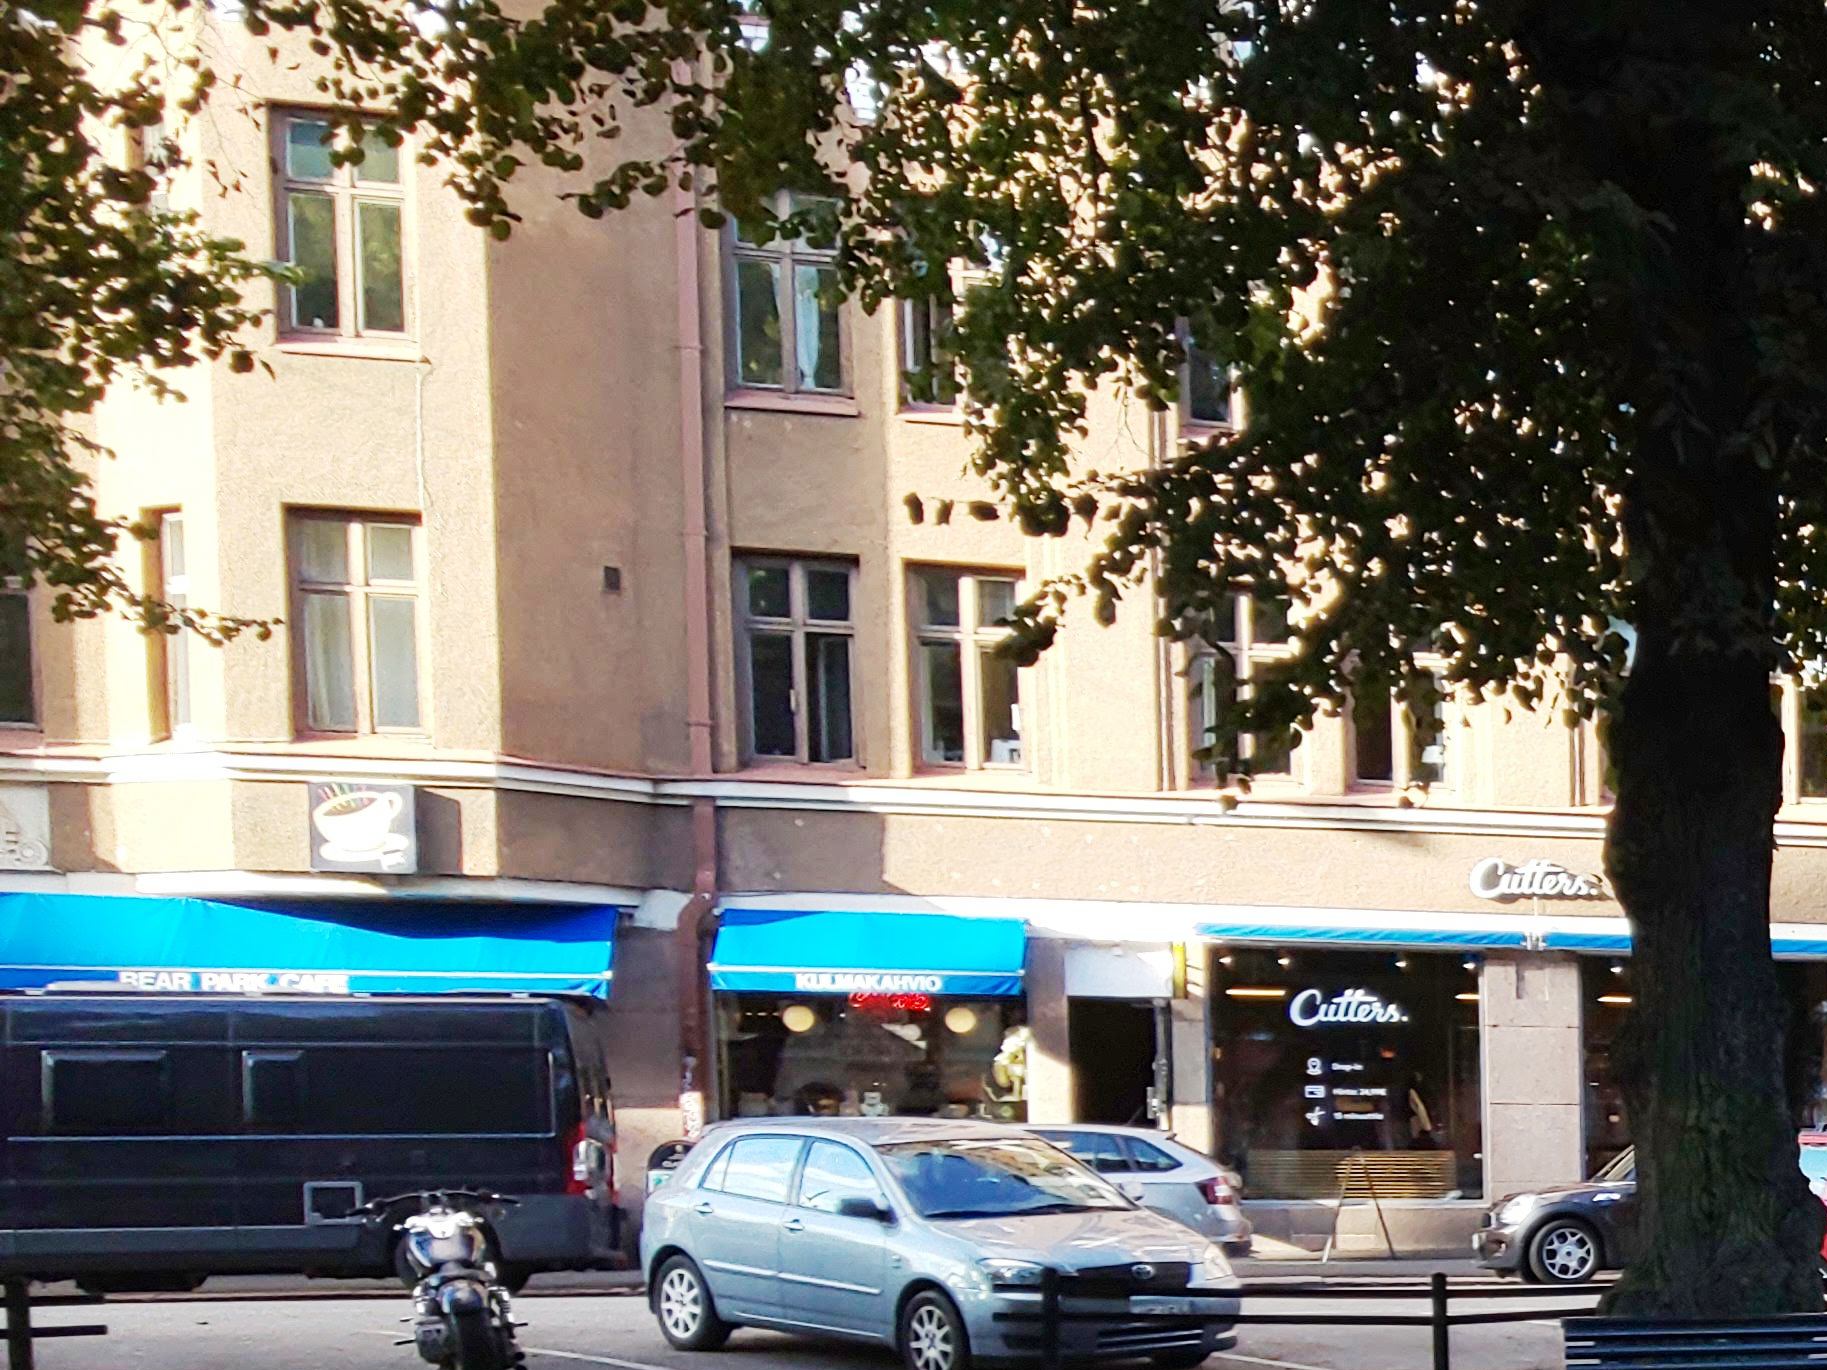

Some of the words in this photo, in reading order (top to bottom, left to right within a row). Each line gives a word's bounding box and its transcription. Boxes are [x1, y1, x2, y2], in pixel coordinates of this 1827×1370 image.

[1469, 856, 1599, 899] Cutters.
[796, 974, 942, 991] KULMAKAHVIO
[1289, 989, 1409, 1027] Cutters.
